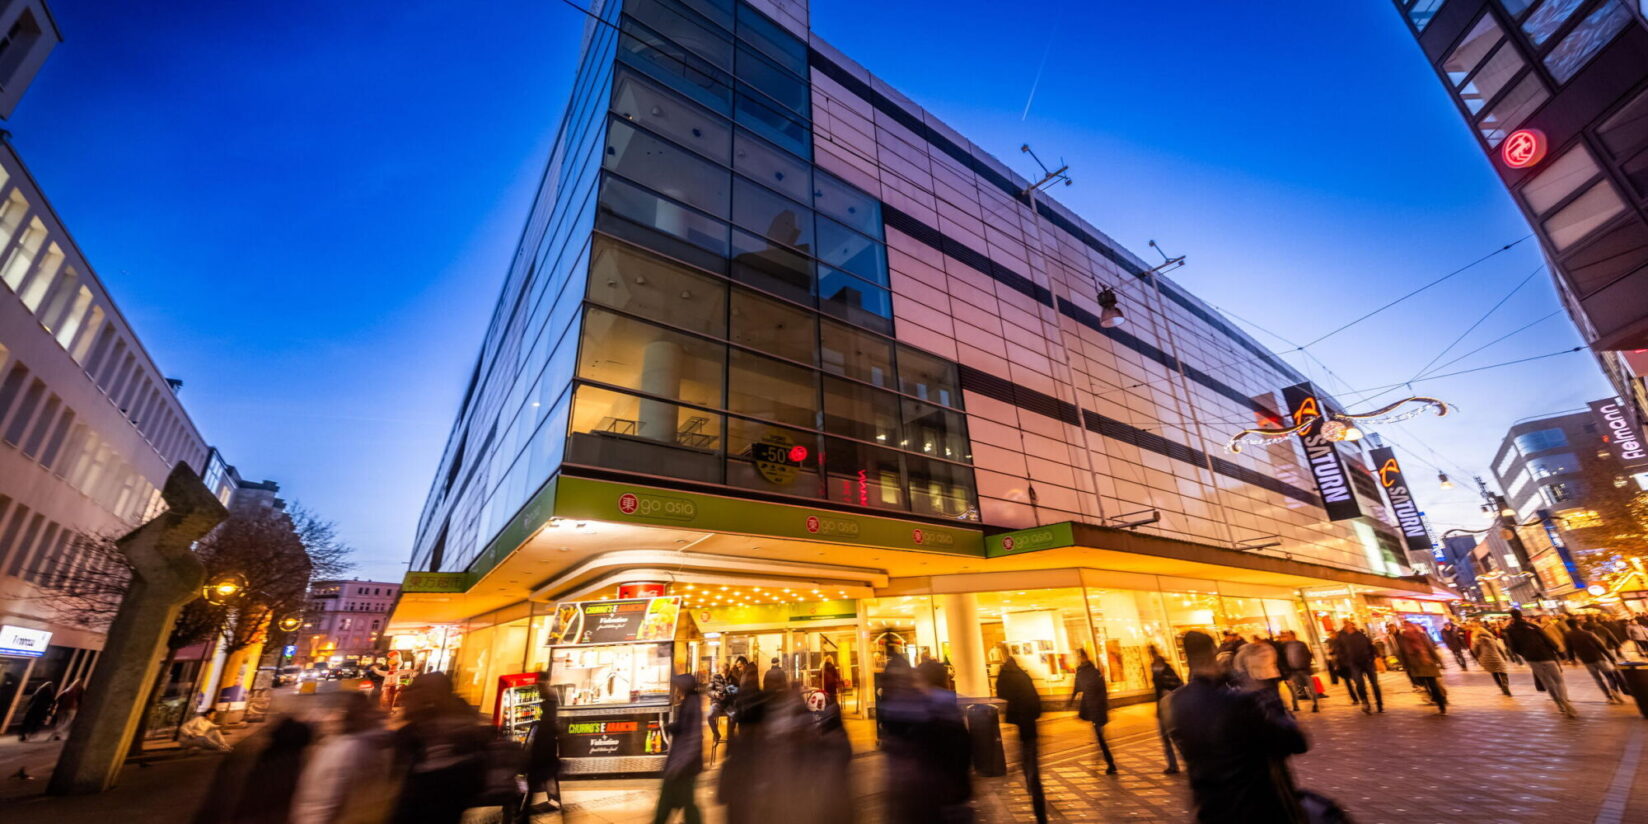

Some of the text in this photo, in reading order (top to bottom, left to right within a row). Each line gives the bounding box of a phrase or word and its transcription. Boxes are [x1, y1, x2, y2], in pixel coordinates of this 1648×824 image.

[1304, 433, 1350, 503] SATURN
[641, 499, 694, 515] go asia
[1389, 486, 1425, 538] SATURN
[822, 520, 858, 534] go asia
[924, 532, 935, 544] go
[1014, 532, 1053, 548] go asia
